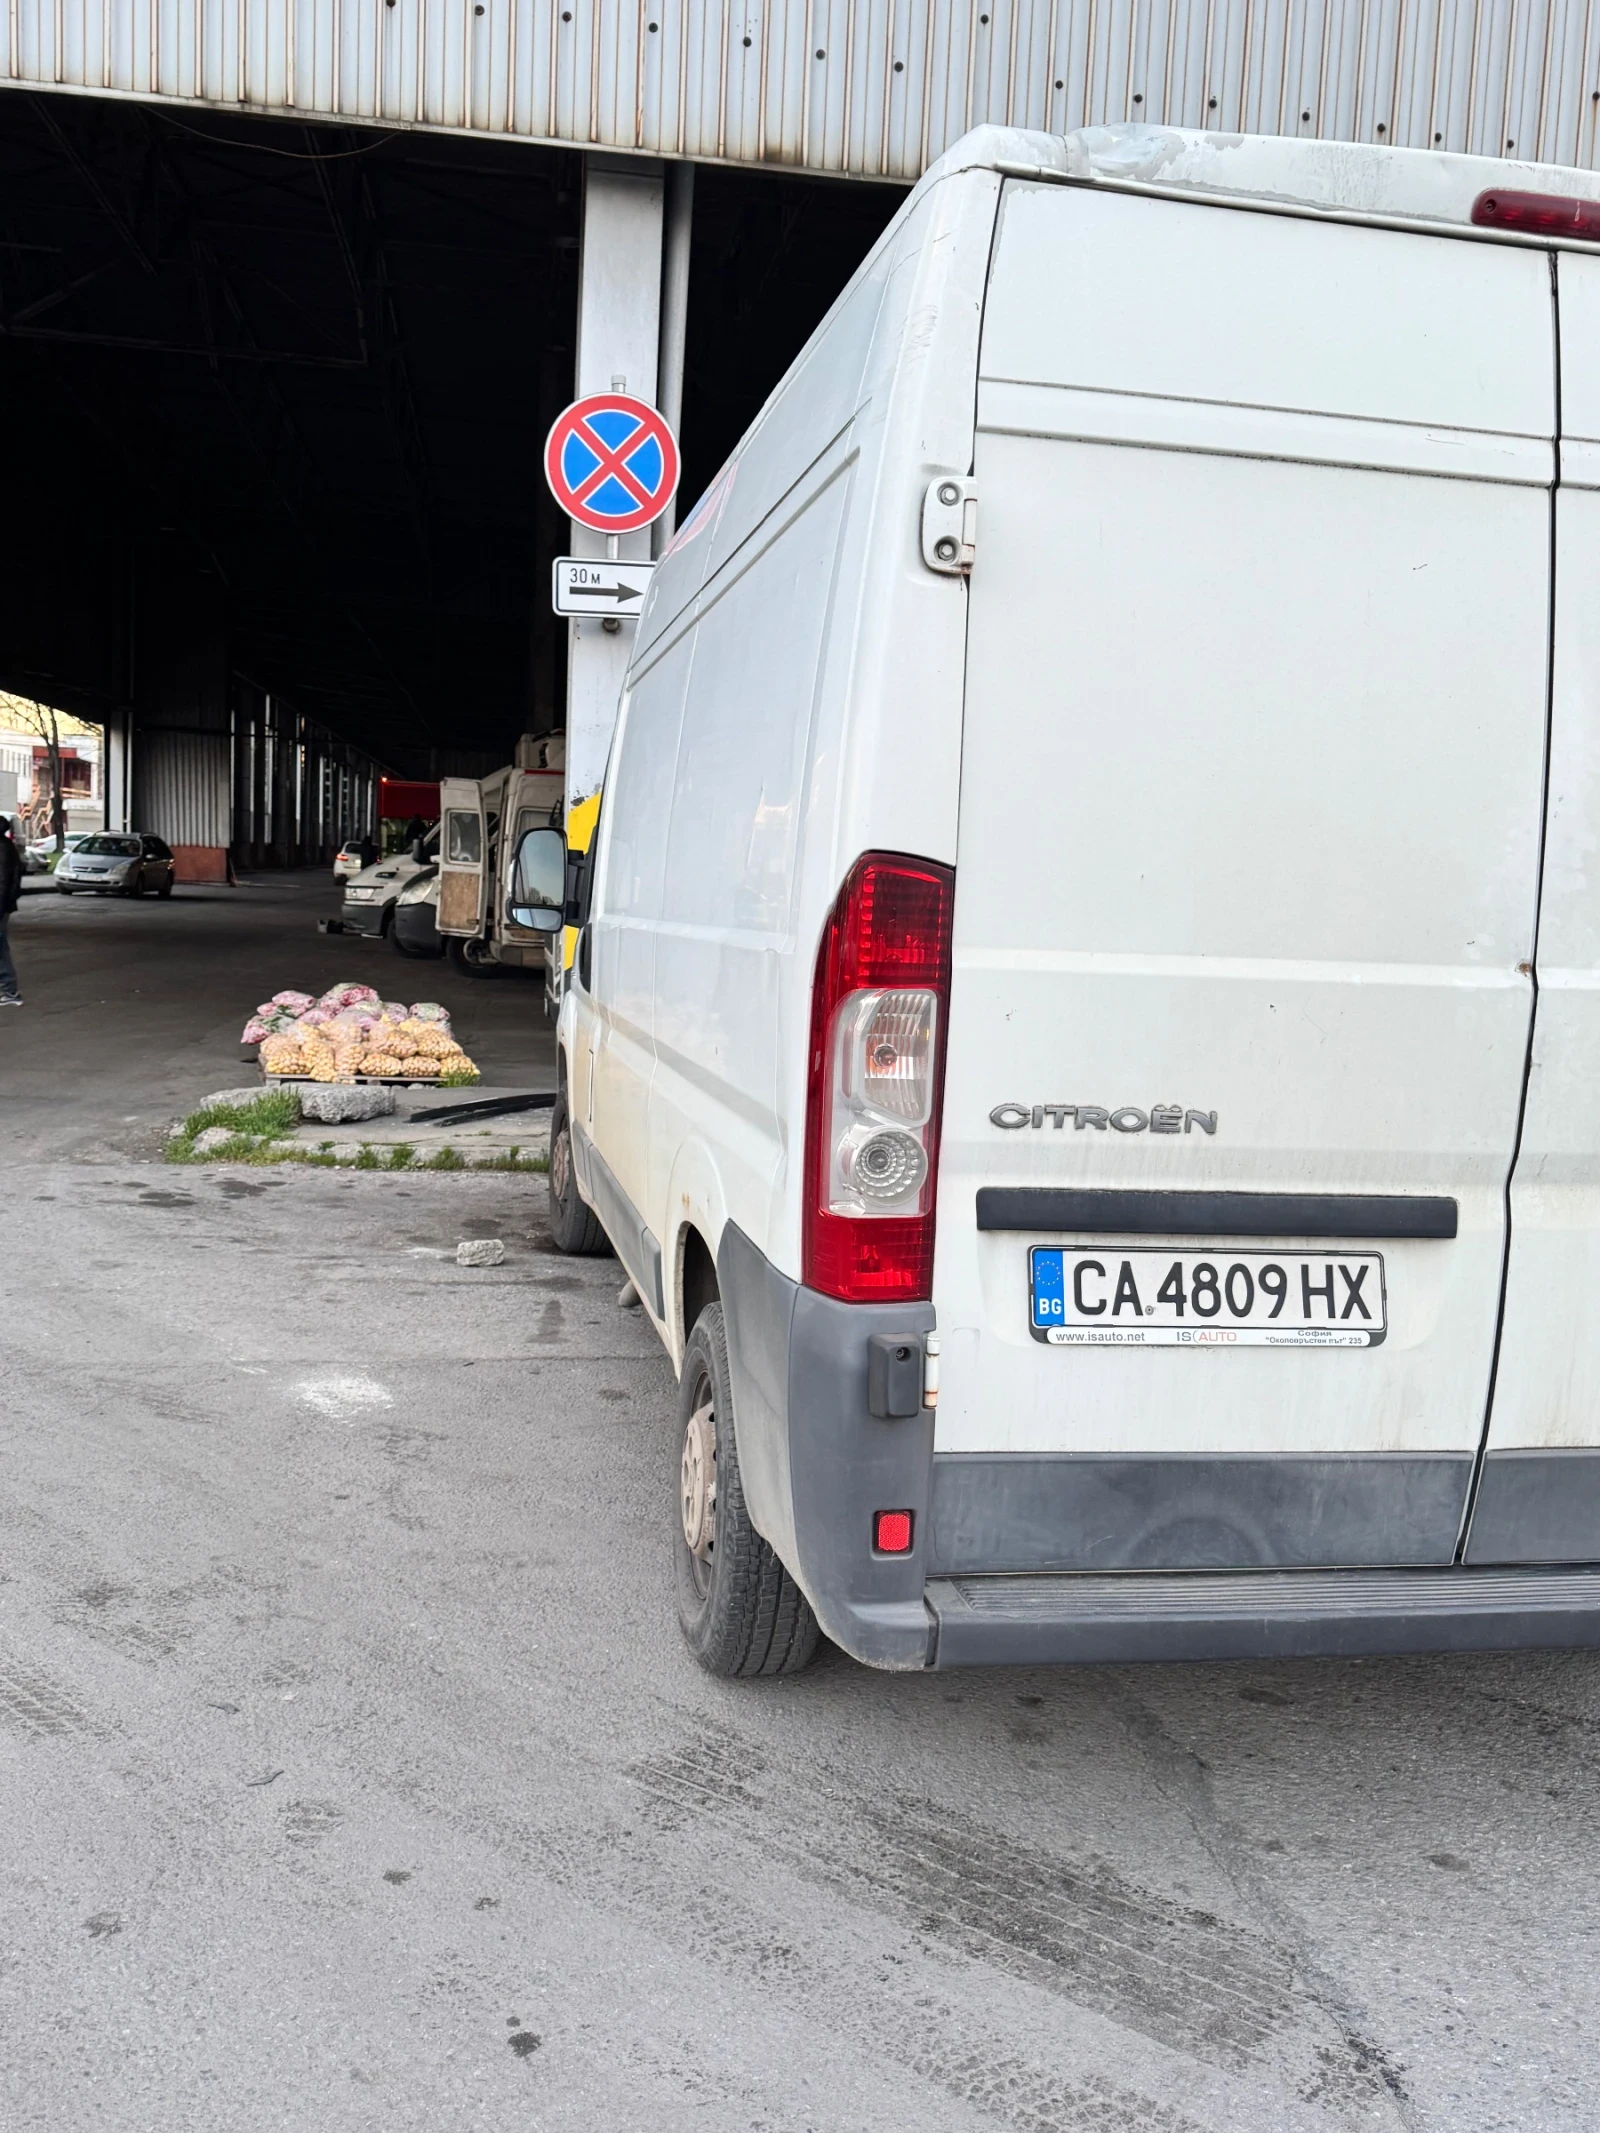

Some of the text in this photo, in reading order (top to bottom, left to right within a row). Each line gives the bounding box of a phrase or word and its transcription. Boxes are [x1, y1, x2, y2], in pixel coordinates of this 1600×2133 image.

[570, 568, 587, 583] 30
[989, 1103, 1218, 1135] CITROËN
[1039, 1297, 1062, 1315] BG
[1055, 1331, 1145, 1342] www.isauto.net
